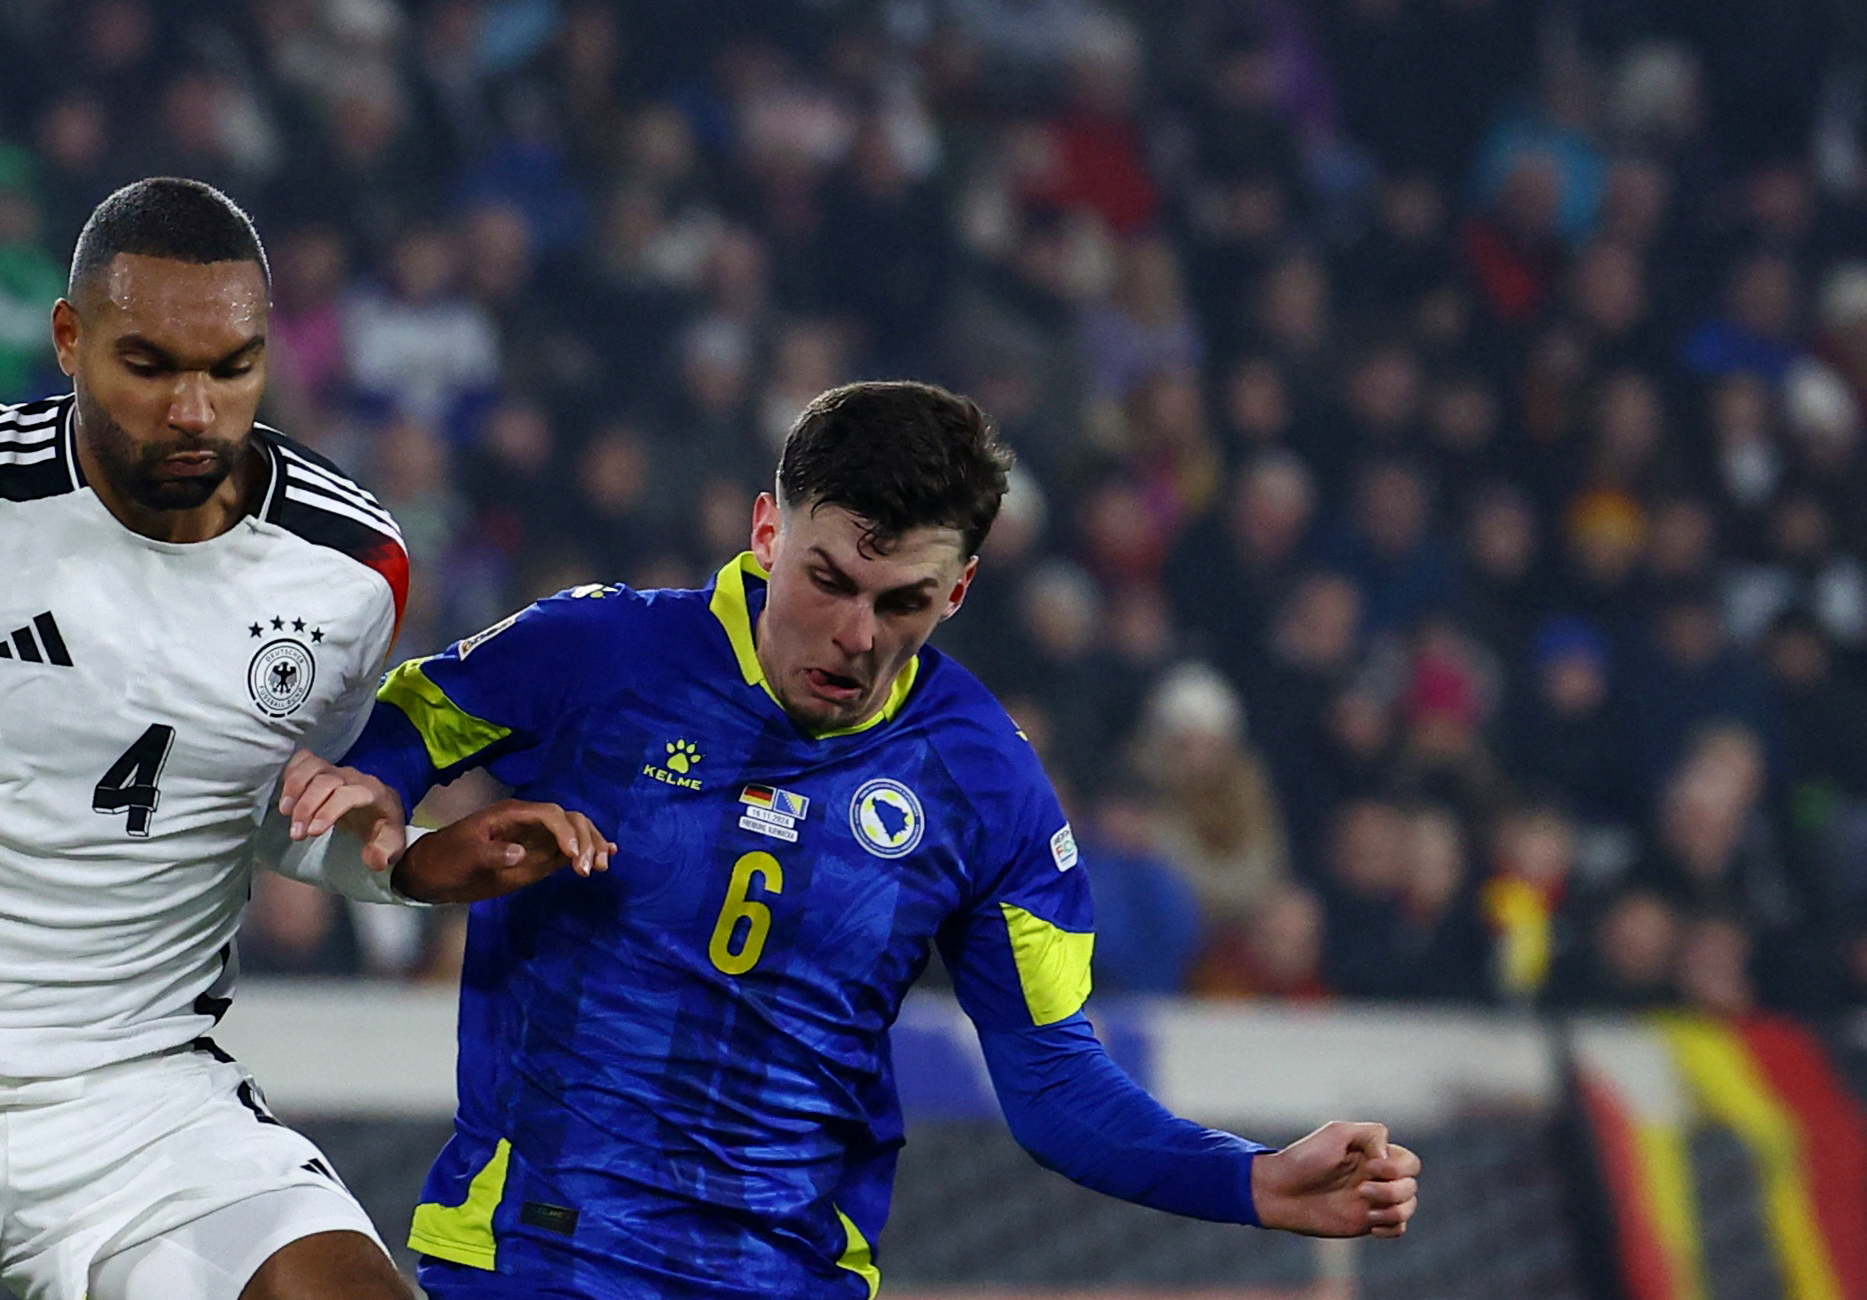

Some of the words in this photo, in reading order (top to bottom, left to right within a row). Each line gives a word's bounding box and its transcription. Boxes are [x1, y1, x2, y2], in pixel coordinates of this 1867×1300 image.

[265, 648, 305, 664] DEUTSCHER
[91, 723, 176, 838] 4
[642, 764, 703, 790] KELME
[709, 851, 783, 975] 6
